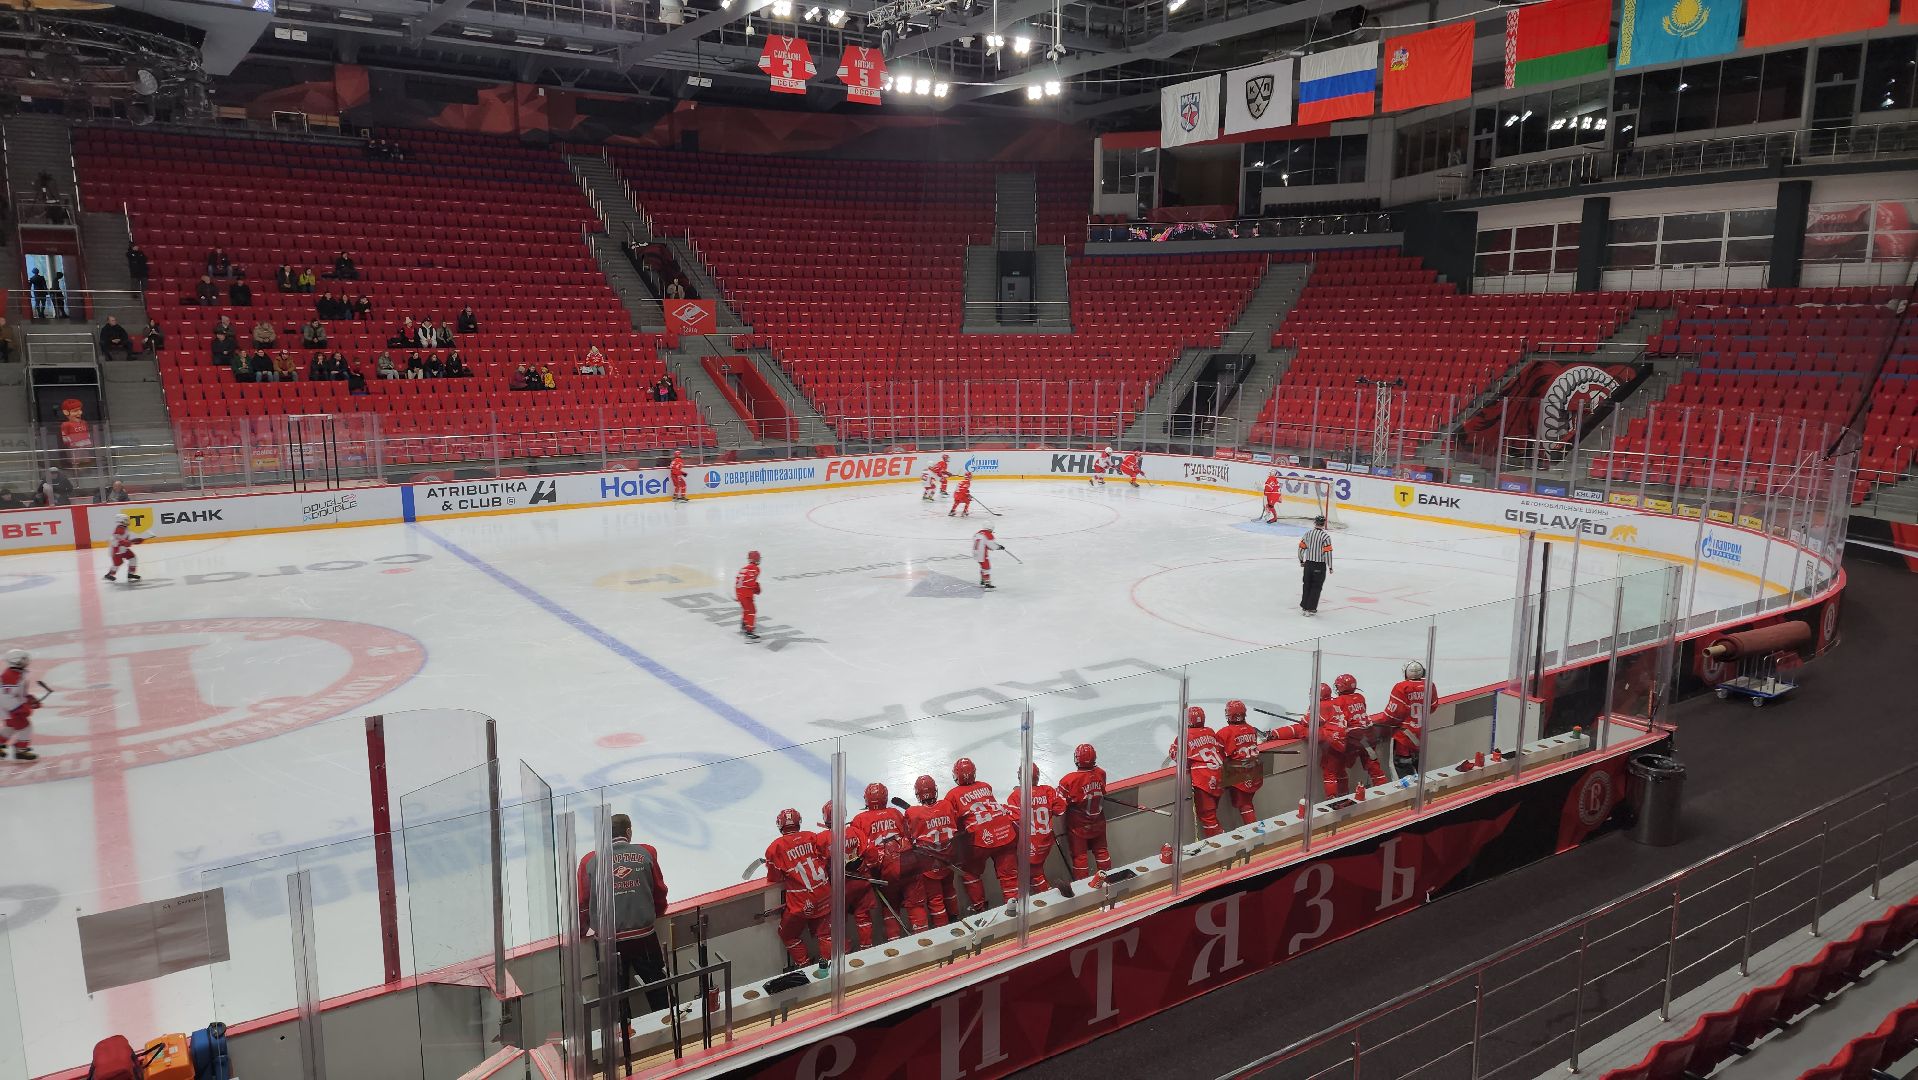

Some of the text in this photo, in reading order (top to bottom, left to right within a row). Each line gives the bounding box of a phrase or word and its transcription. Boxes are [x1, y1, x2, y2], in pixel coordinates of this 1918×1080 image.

[782, 60, 793, 78] 3
[859, 69, 870, 87] 5
[825, 456, 917, 482] FONBET
[1184, 462, 1230, 483] ТУЛЬСКИЙ
[427, 481, 528, 498] ATRIBUTIKA
[600, 473, 670, 498] Haier
[441, 501, 453, 511] &
[458, 496, 502, 510] CLUB
[1399, 491, 1461, 509] Т БАНК
[129, 508, 224, 527] Т БАНК
[1504, 507, 1608, 536] GISLAVED
[1, 520, 62, 539] BET
